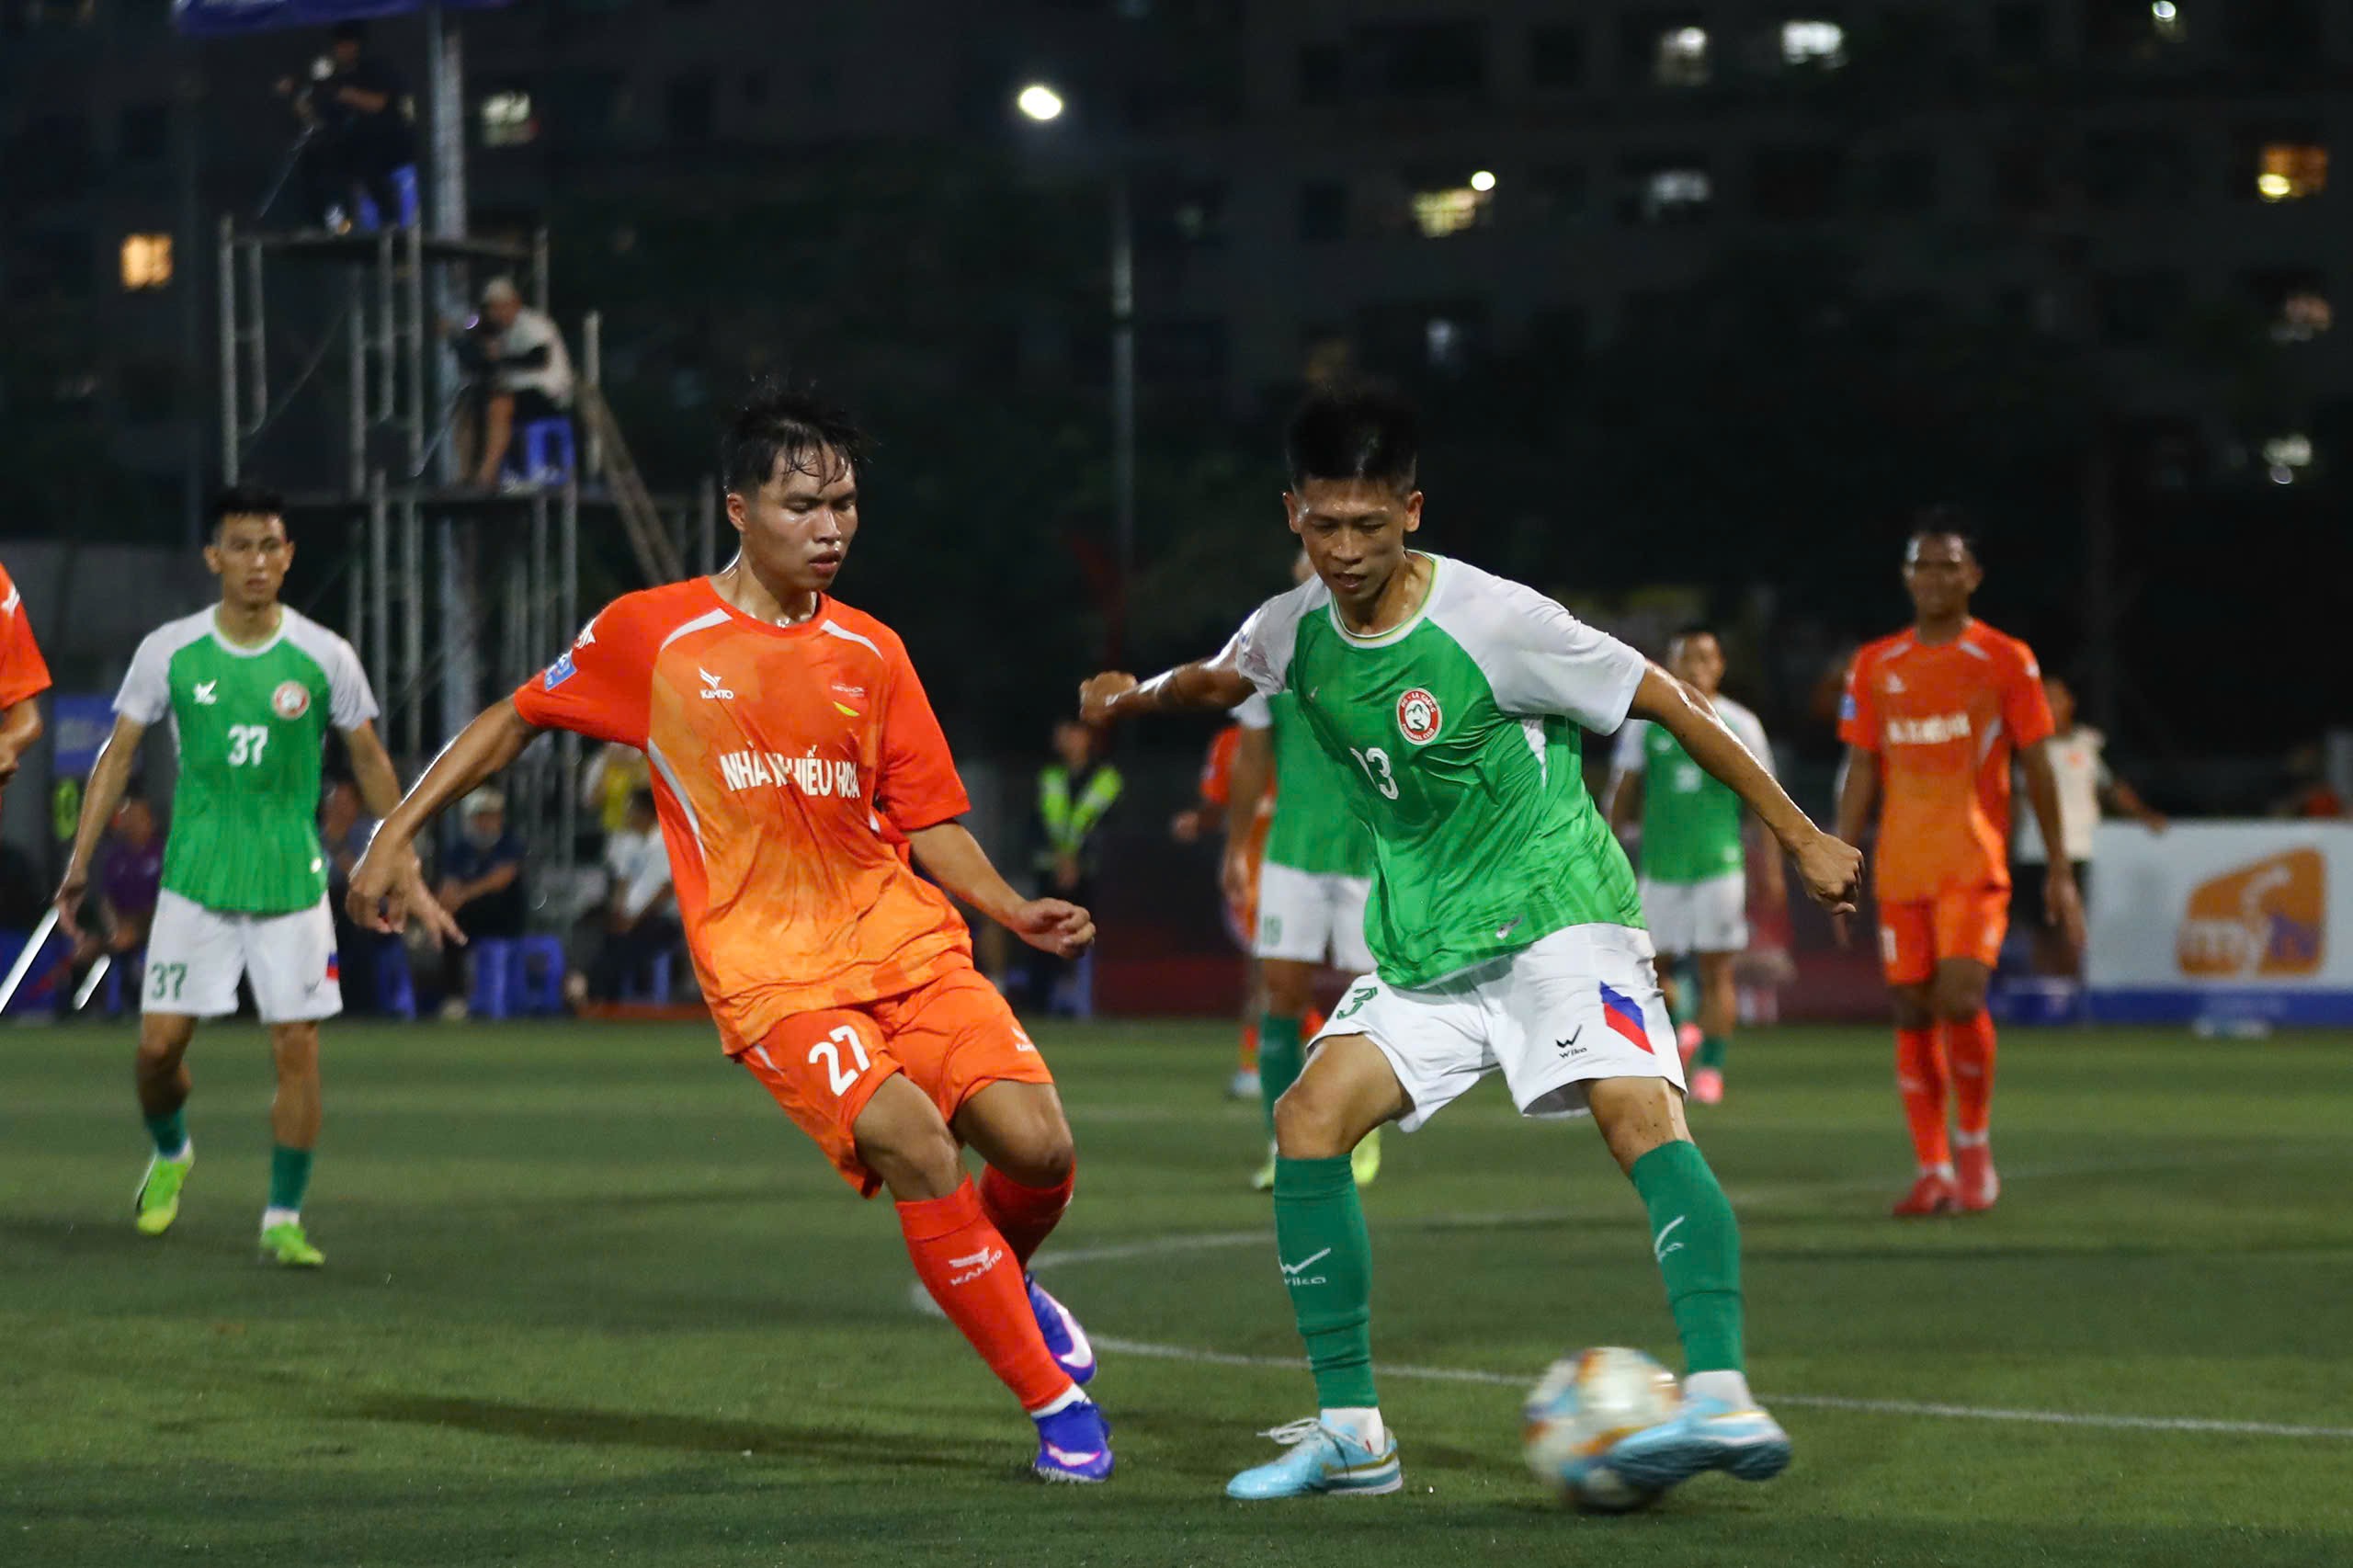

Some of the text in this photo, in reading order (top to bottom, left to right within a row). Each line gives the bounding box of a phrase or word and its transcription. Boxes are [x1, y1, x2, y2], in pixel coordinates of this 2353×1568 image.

[227, 723, 269, 767] 37
[720, 740, 773, 792] NHÀ
[835, 760, 861, 799] HOA
[1348, 746, 1400, 801] 13
[151, 961, 188, 1001] 37
[808, 1024, 872, 1097] 27
